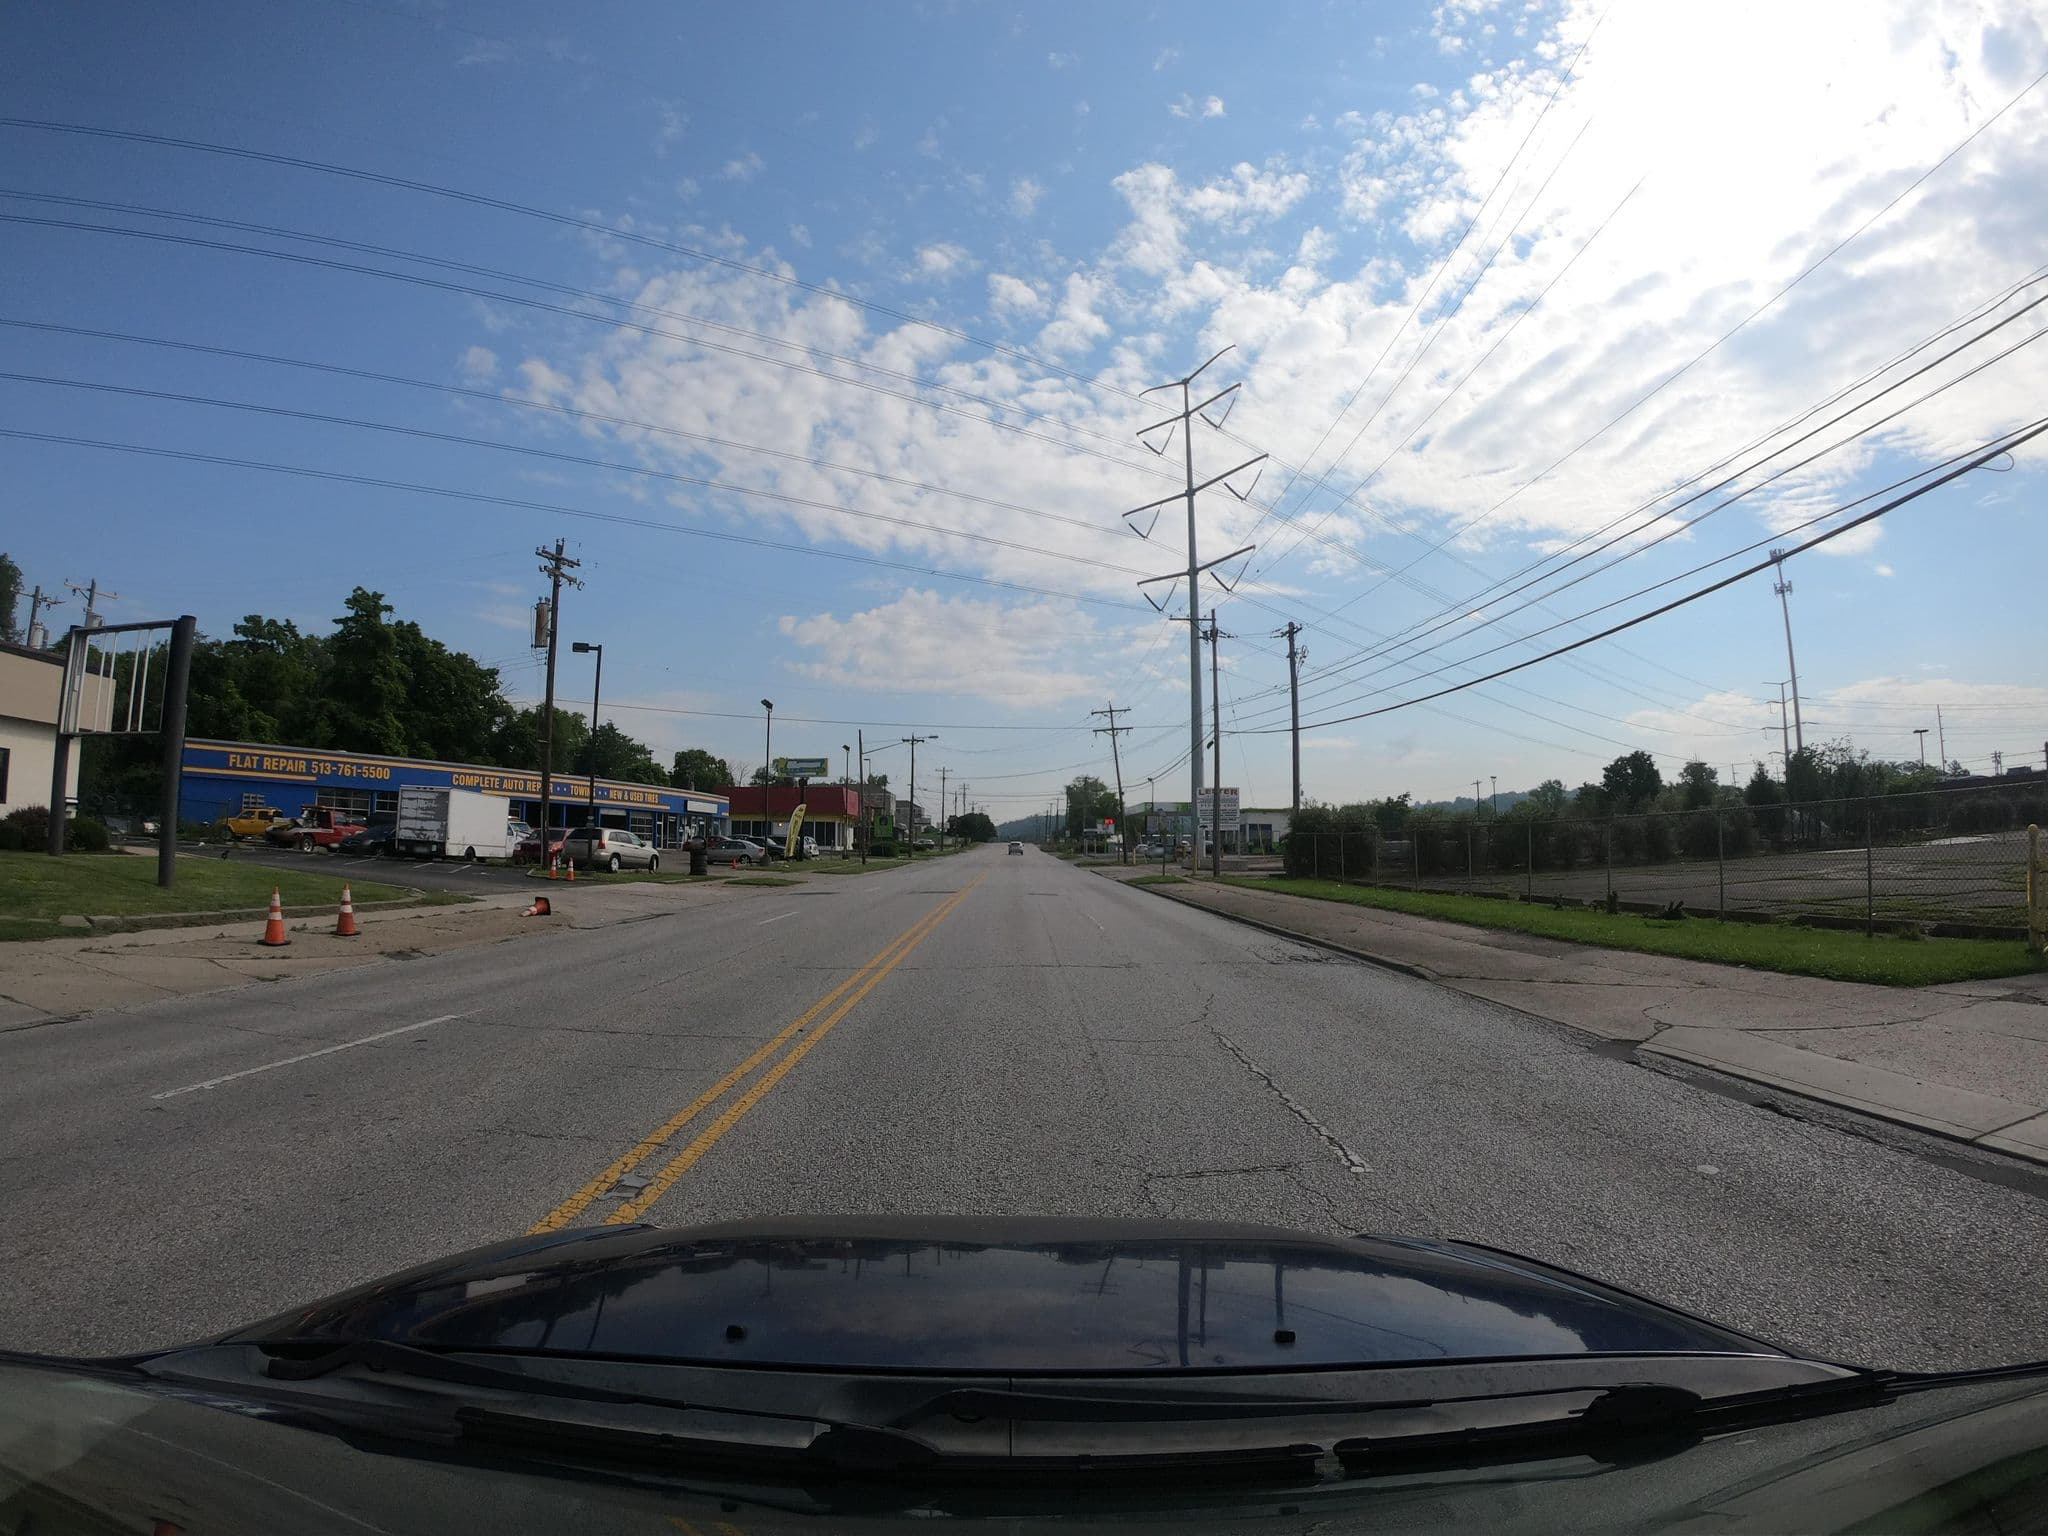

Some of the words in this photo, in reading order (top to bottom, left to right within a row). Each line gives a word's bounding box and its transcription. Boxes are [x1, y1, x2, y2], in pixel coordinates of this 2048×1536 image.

[229, 754, 259, 769] FLAT
[263, 756, 307, 773] REPAIR
[311, 761, 390, 780] 513-761-5500
[452, 774, 500, 789] COMPLETE
[502, 779, 524, 791] AUTO
[526, 780, 554, 793] REPR
[609, 789, 623, 801] NEW
[629, 791, 644, 802] USED
